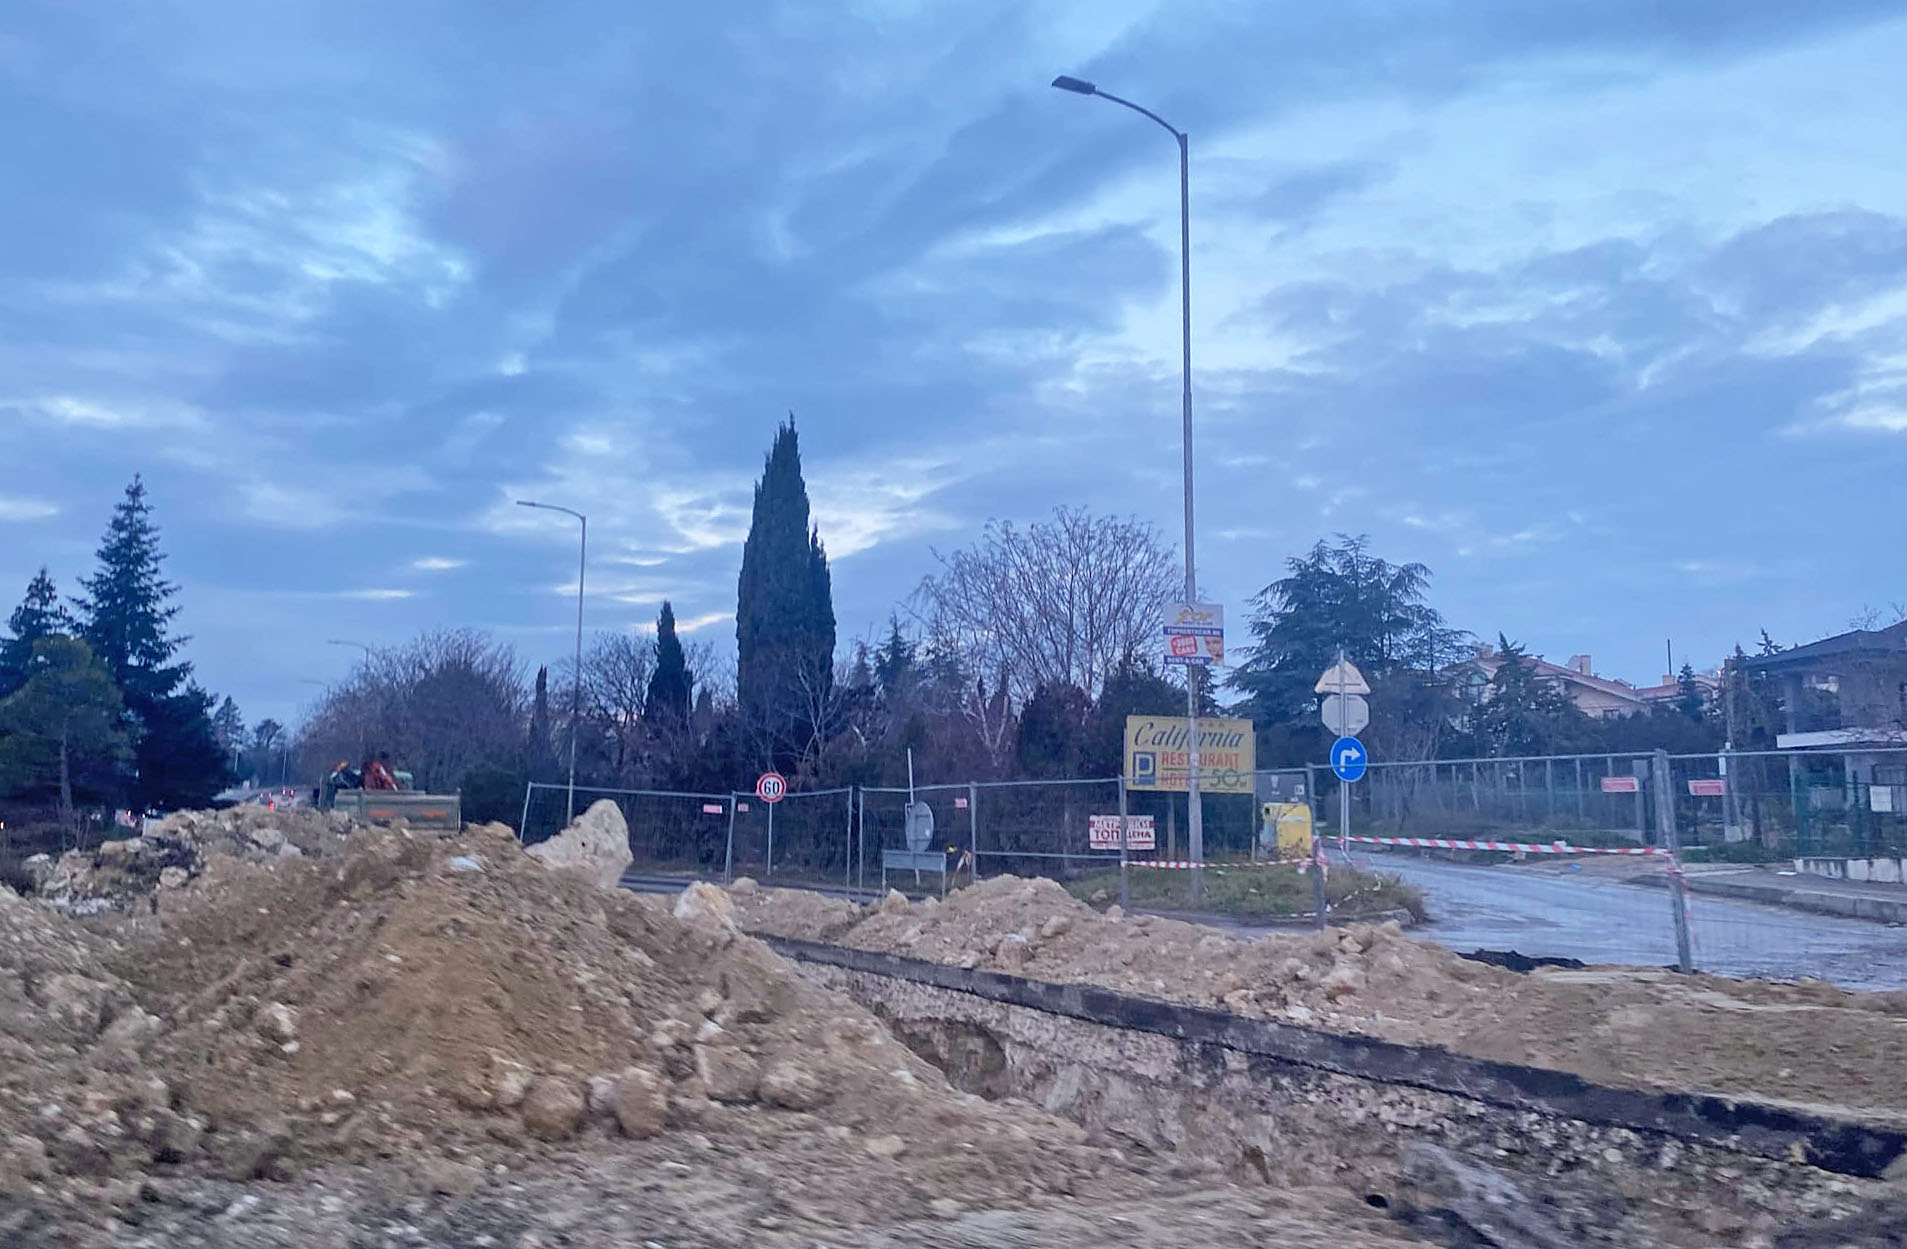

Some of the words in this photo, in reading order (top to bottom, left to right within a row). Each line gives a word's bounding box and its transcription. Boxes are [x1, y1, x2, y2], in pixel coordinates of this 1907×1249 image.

[1134, 722, 1245, 750] Califrnia
[1161, 751, 1239, 768] RESTURANT
[764, 781, 780, 795] 60
[1095, 829, 1119, 840] ТОП
